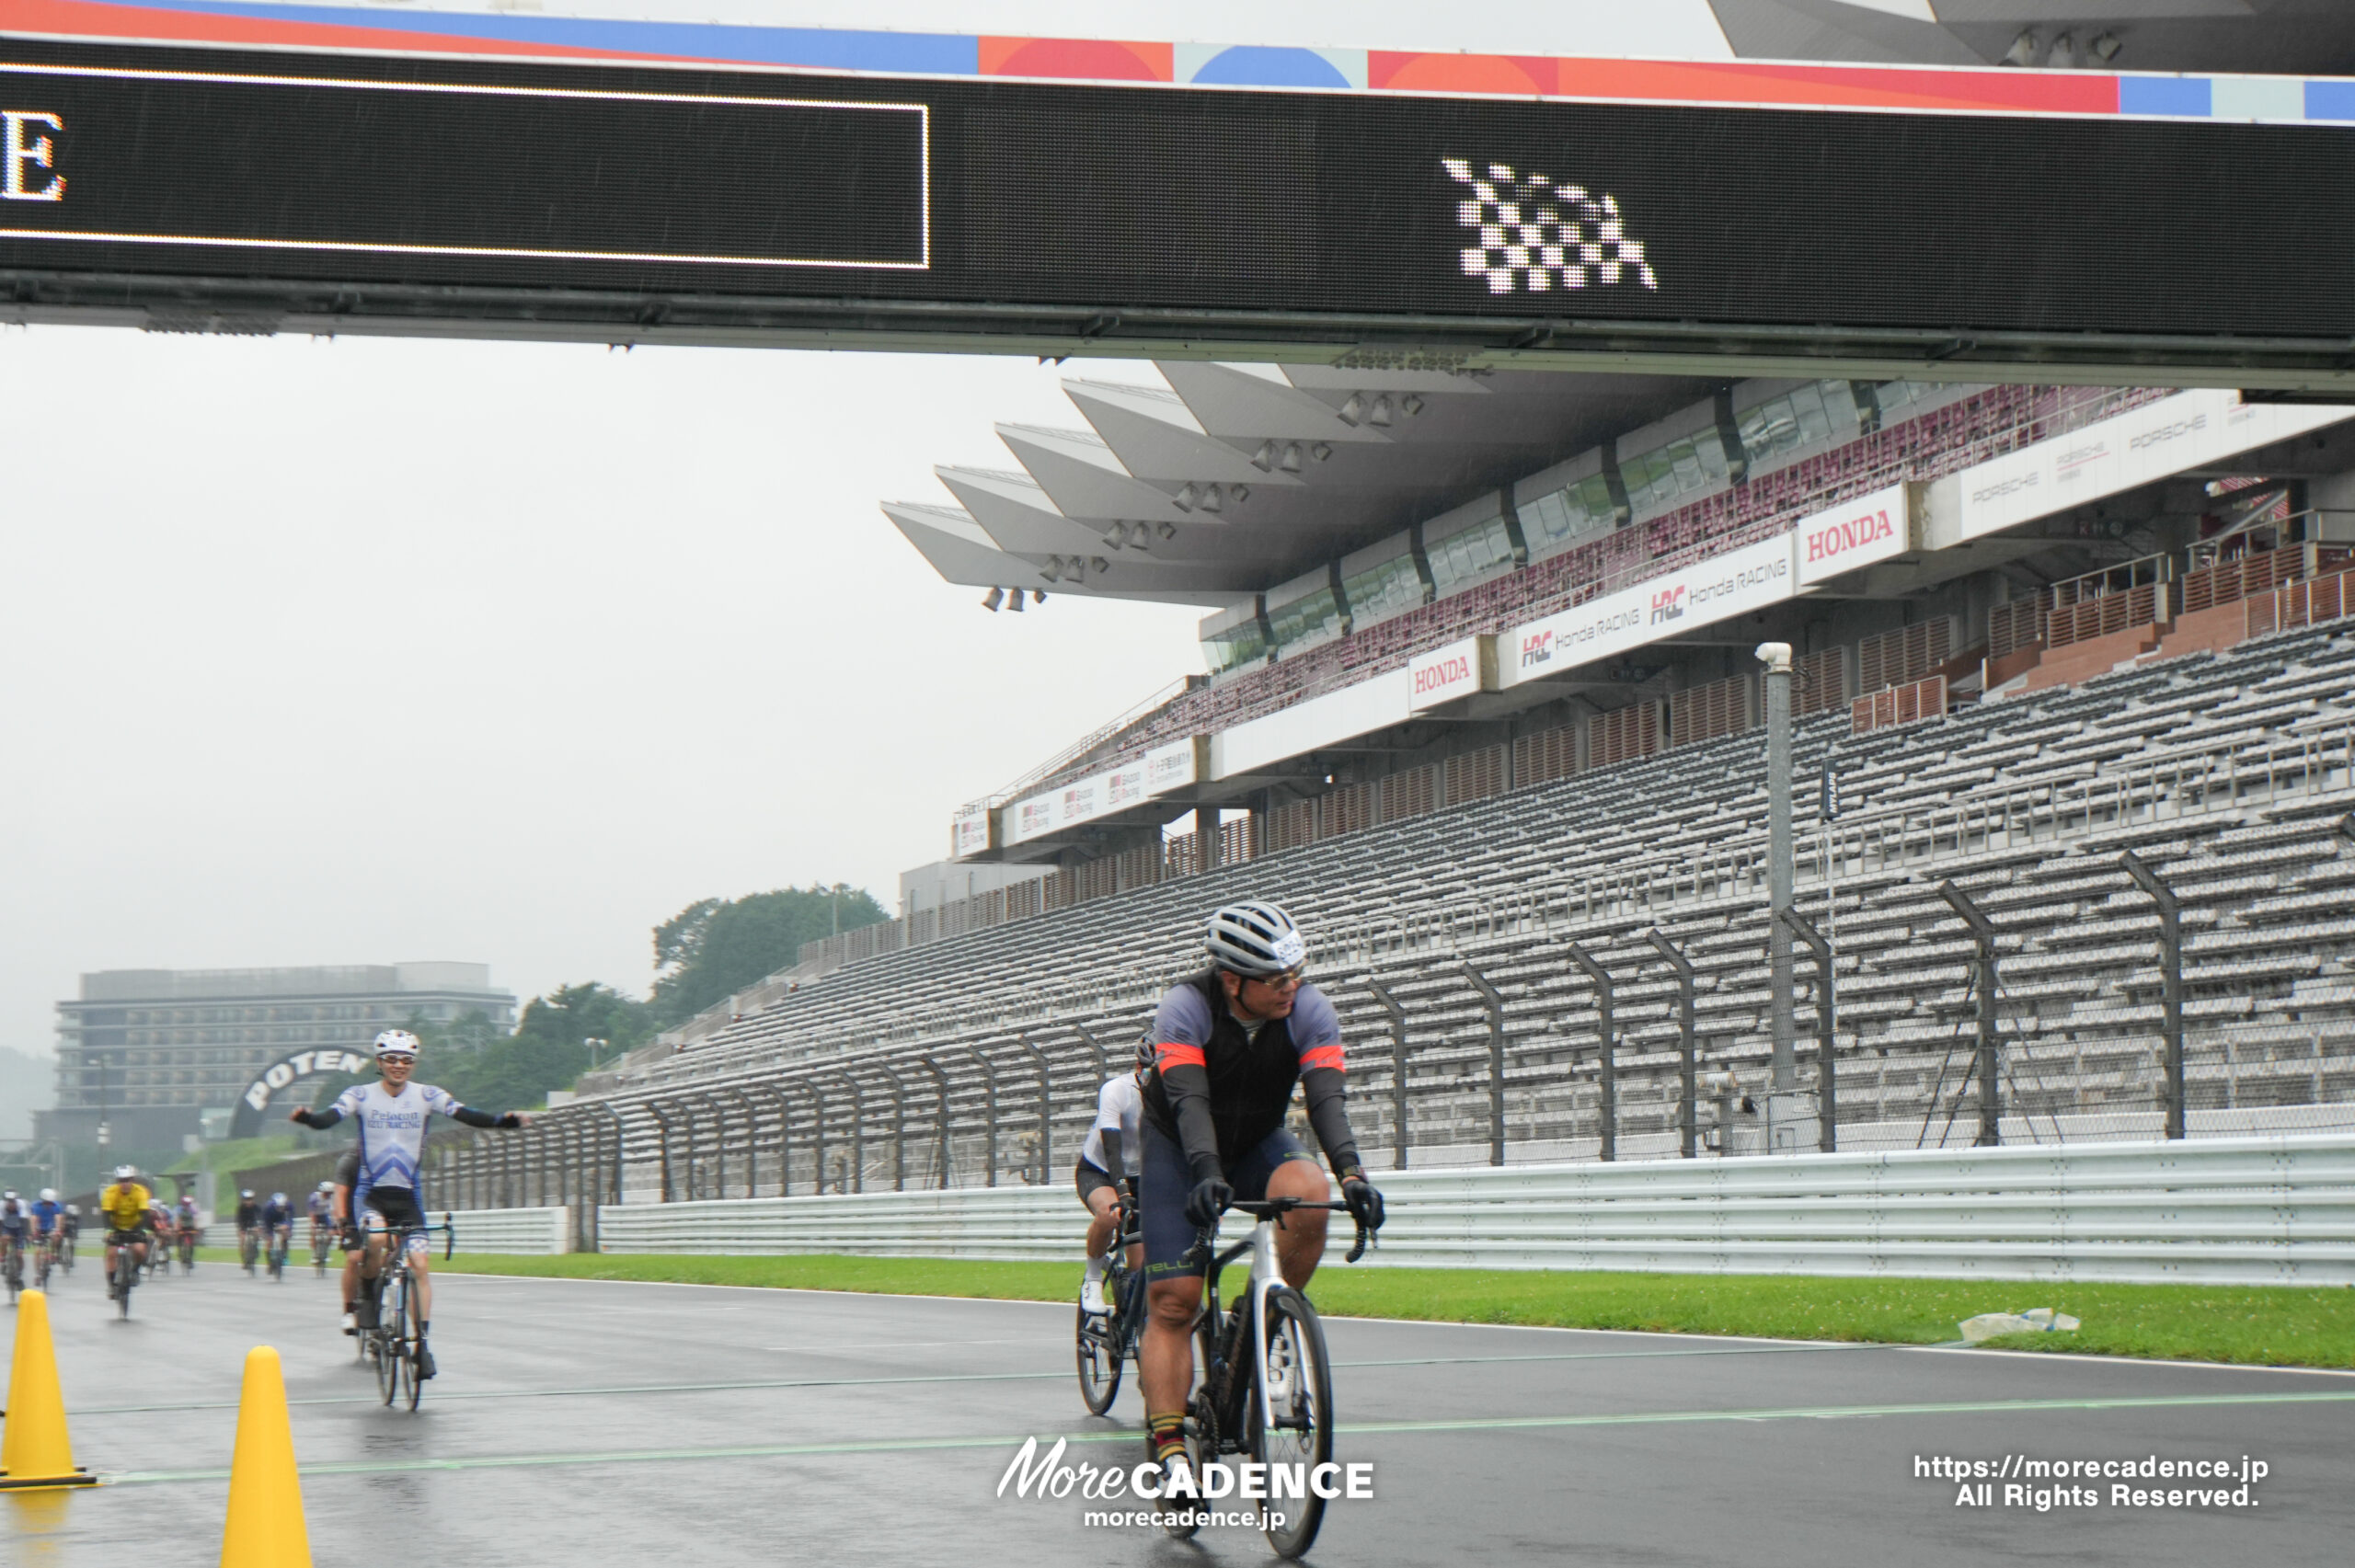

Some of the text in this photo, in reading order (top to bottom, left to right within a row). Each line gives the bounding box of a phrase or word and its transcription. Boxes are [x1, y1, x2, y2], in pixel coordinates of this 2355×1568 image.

[0, 109, 66, 201] E
[2129, 413, 2208, 451] PORSCHE
[1971, 471, 2040, 504] PORSCHE
[1807, 509, 1893, 564] HONDA
[1689, 578, 1734, 607] Honda
[1736, 558, 1788, 590] RACING
[1556, 624, 1596, 651] Honda
[1596, 608, 1641, 636] RACING
[1414, 656, 1471, 694] HONDA
[1828, 772, 1839, 814] MYLAPS
